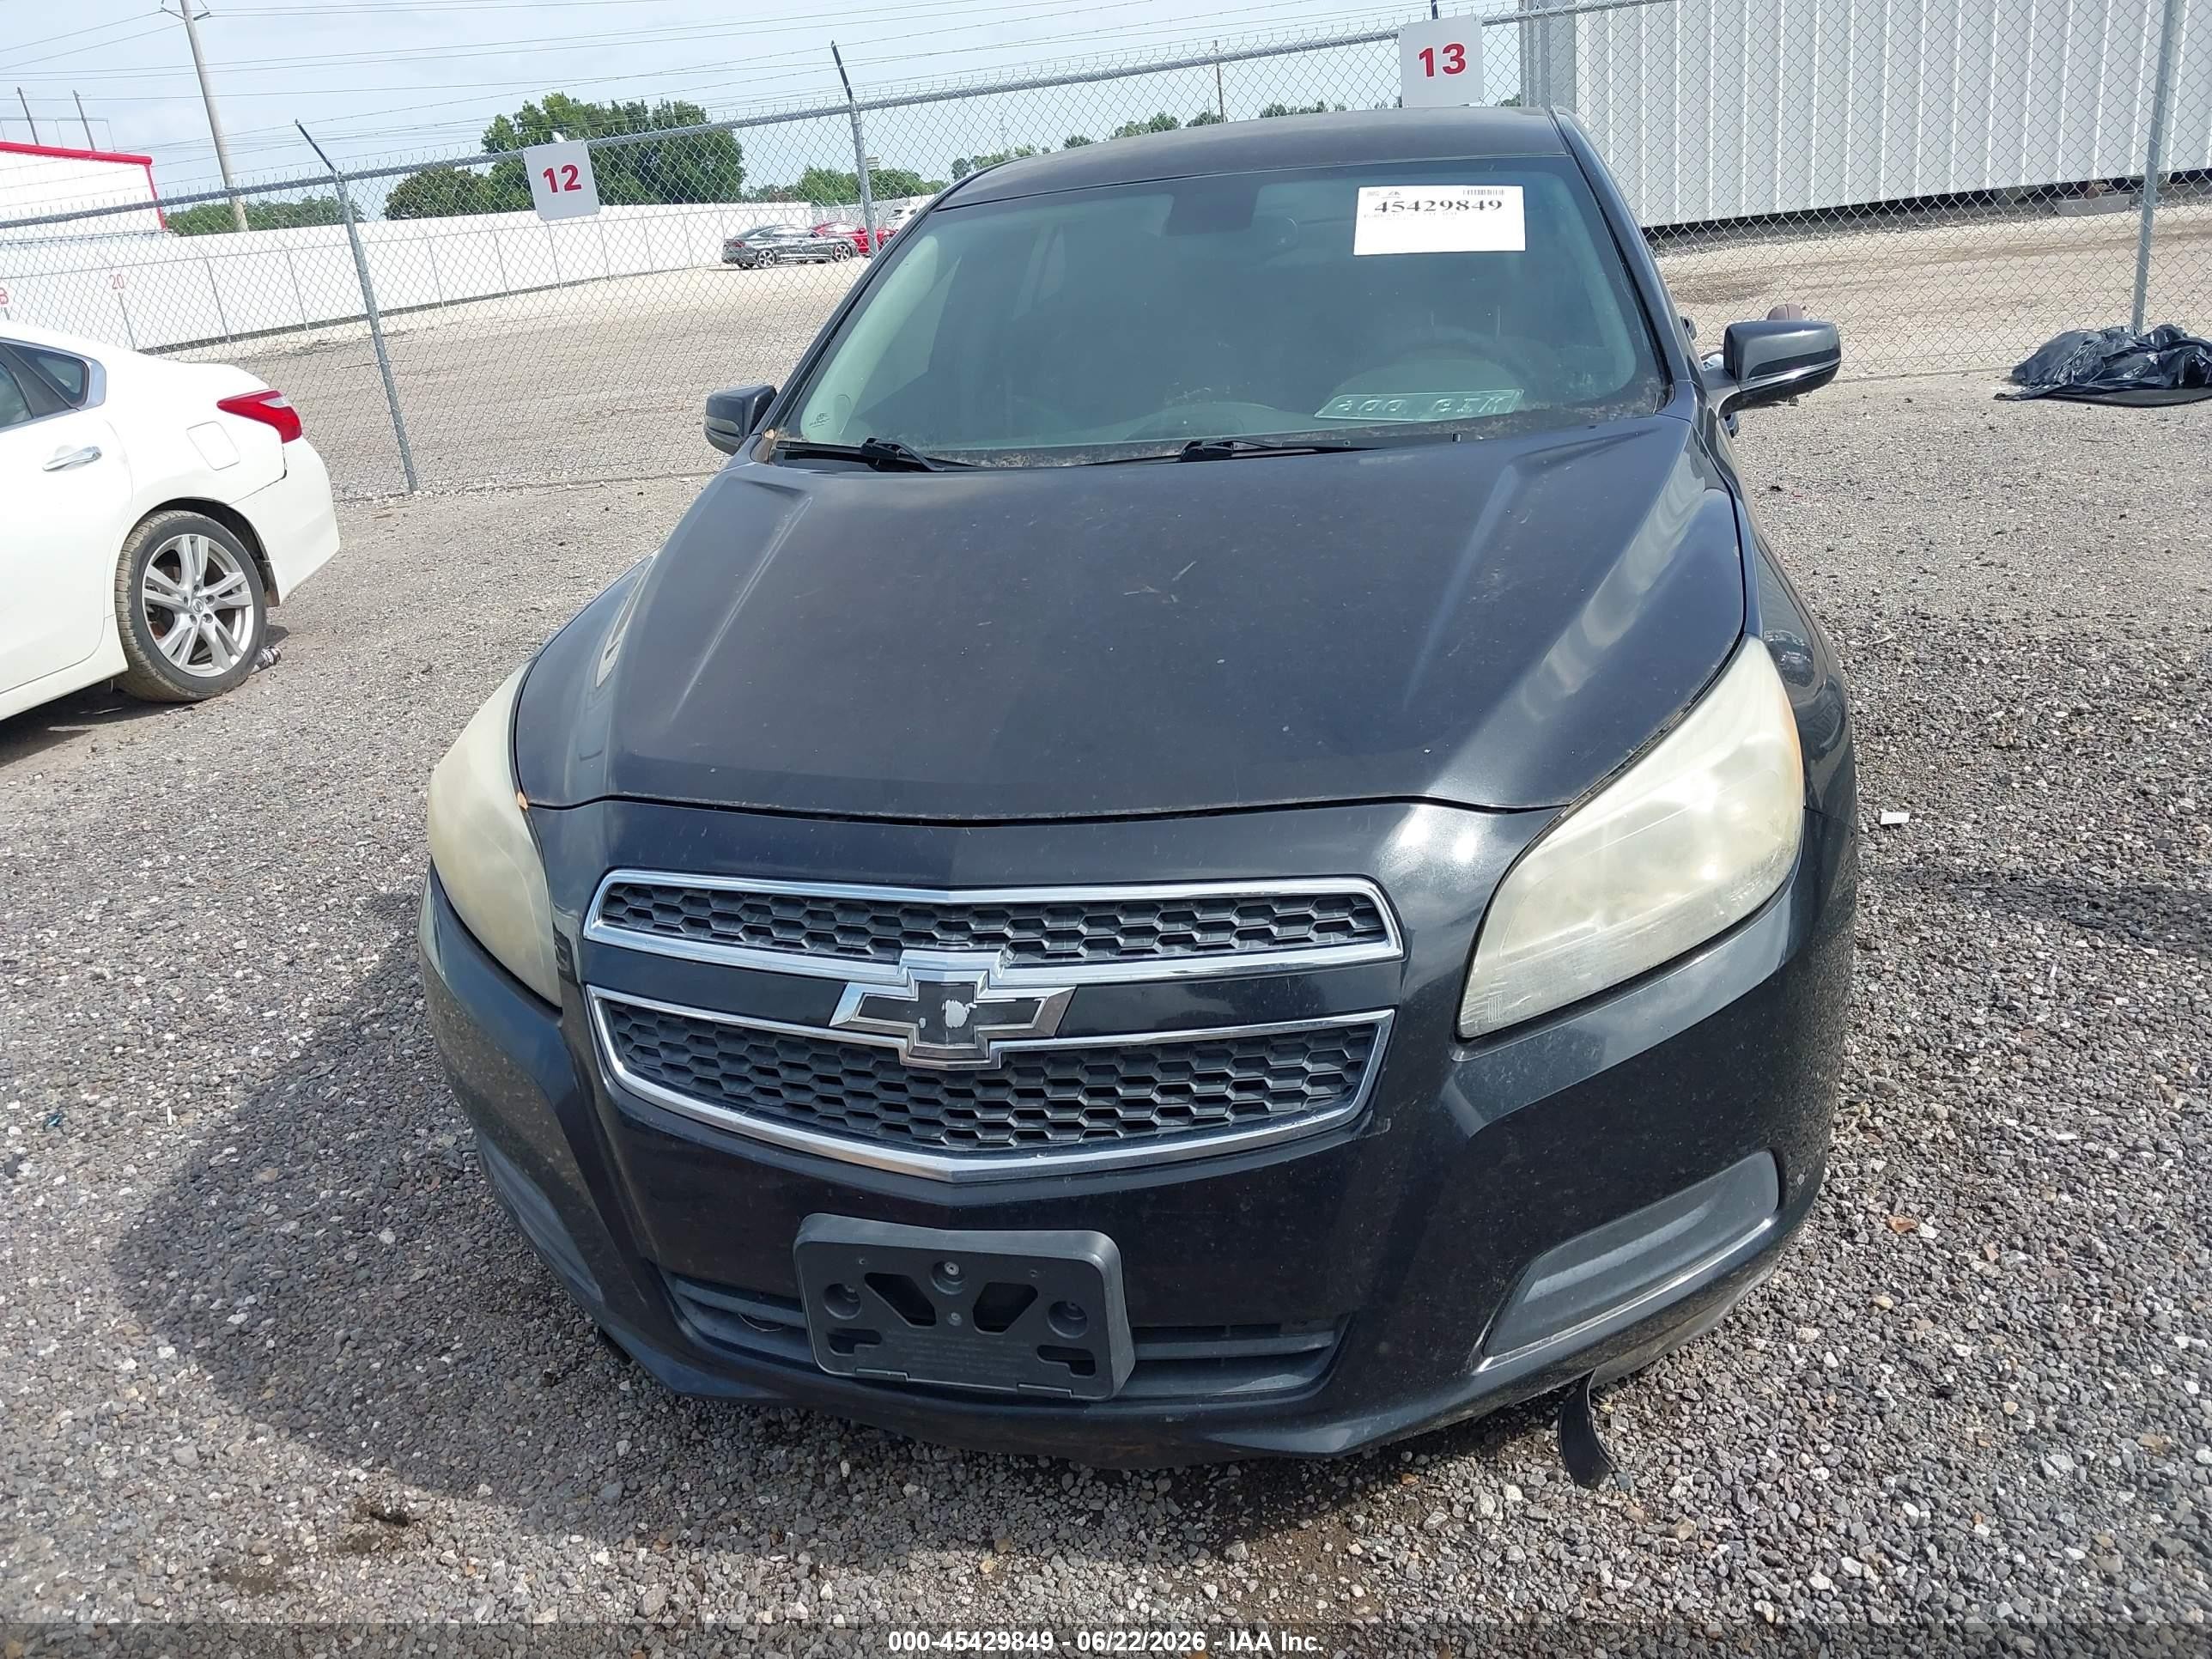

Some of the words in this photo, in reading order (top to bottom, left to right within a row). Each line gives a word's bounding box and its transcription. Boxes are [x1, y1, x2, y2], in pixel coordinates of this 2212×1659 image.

[1419, 43, 1467, 77] 13
[543, 164, 582, 193] 12
[1374, 199, 1504, 213] 45429849
[109, 274, 125, 289] 20
